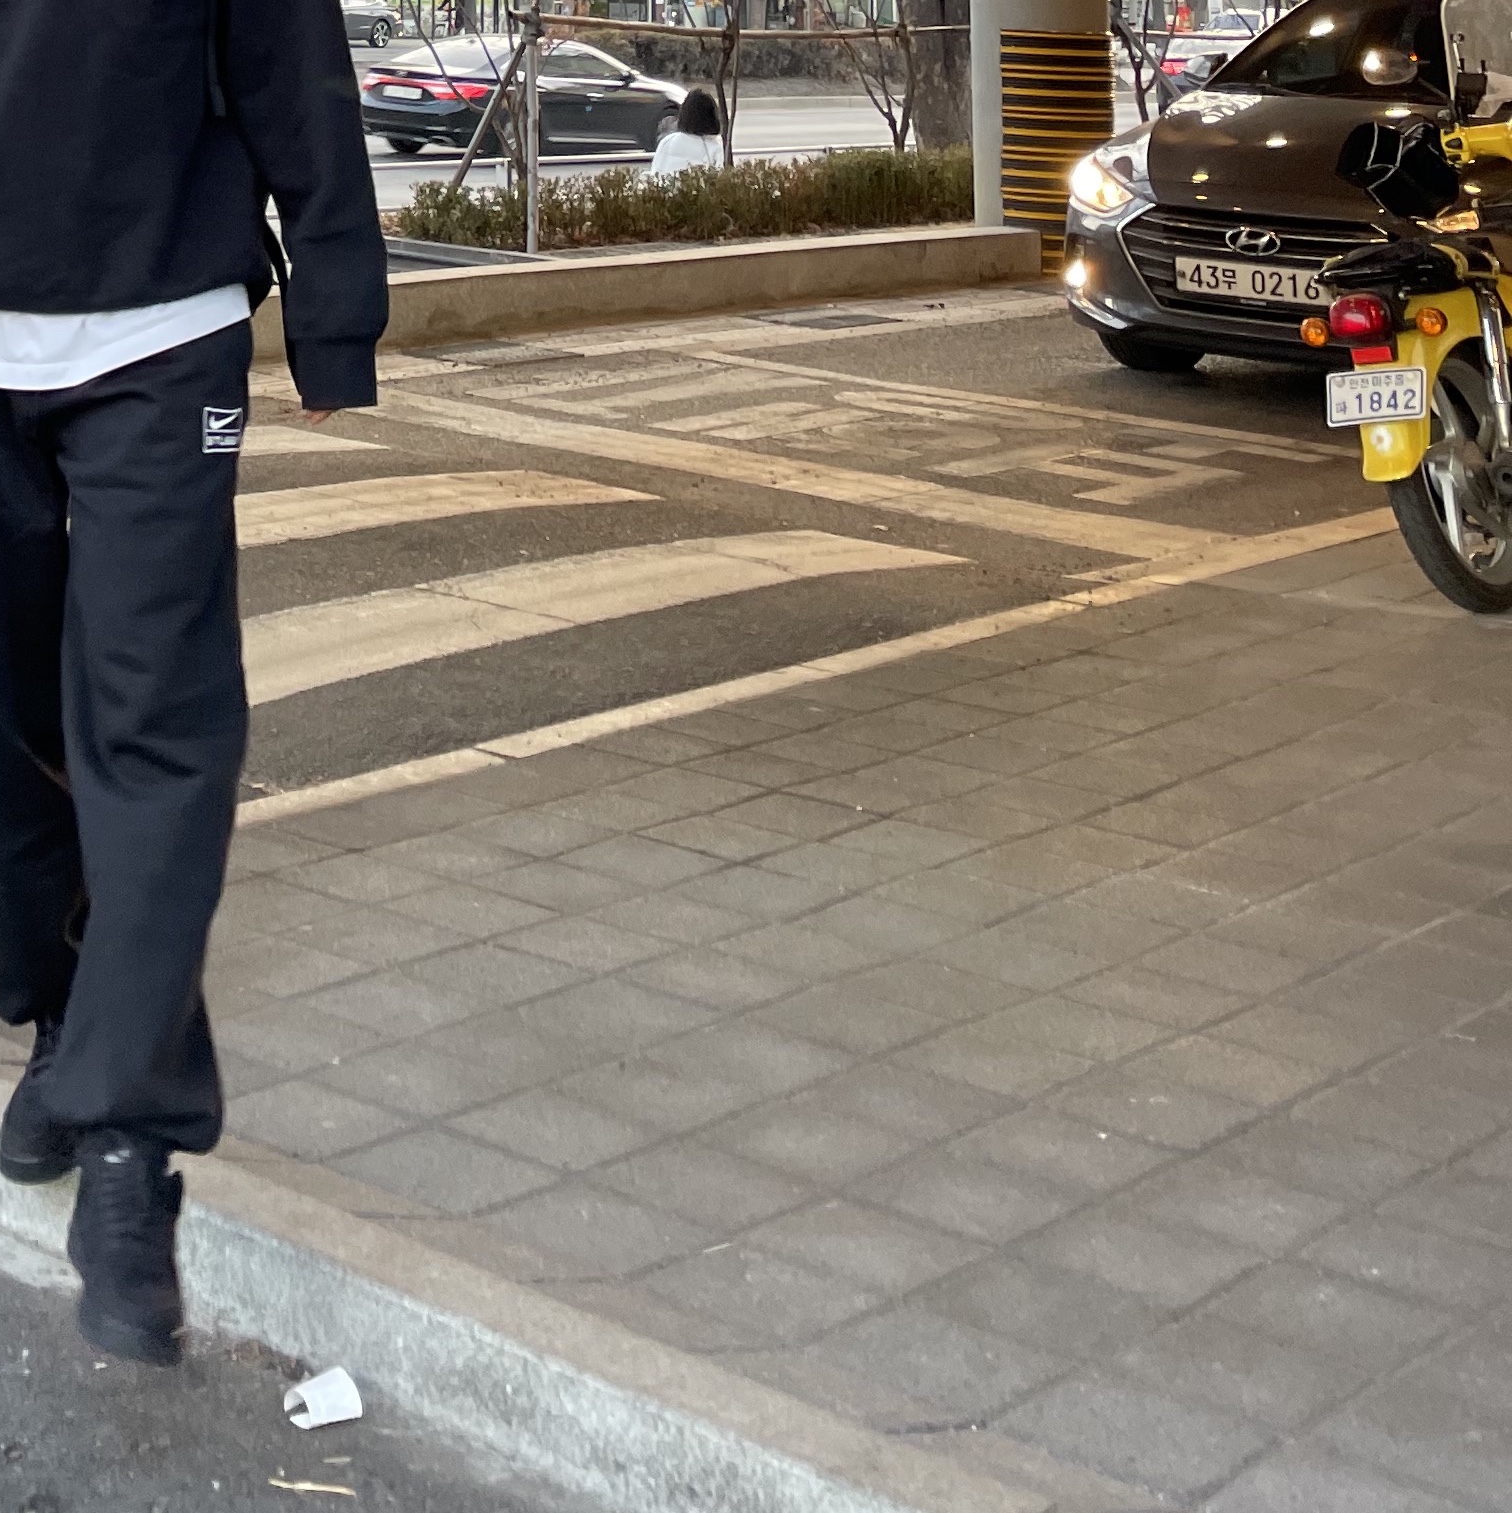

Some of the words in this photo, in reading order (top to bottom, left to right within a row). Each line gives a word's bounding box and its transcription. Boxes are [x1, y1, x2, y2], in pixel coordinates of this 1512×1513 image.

[1189, 263, 1238, 290] 43무
[1251, 269, 1320, 301] 0216
[1355, 388, 1418, 415] 1842
